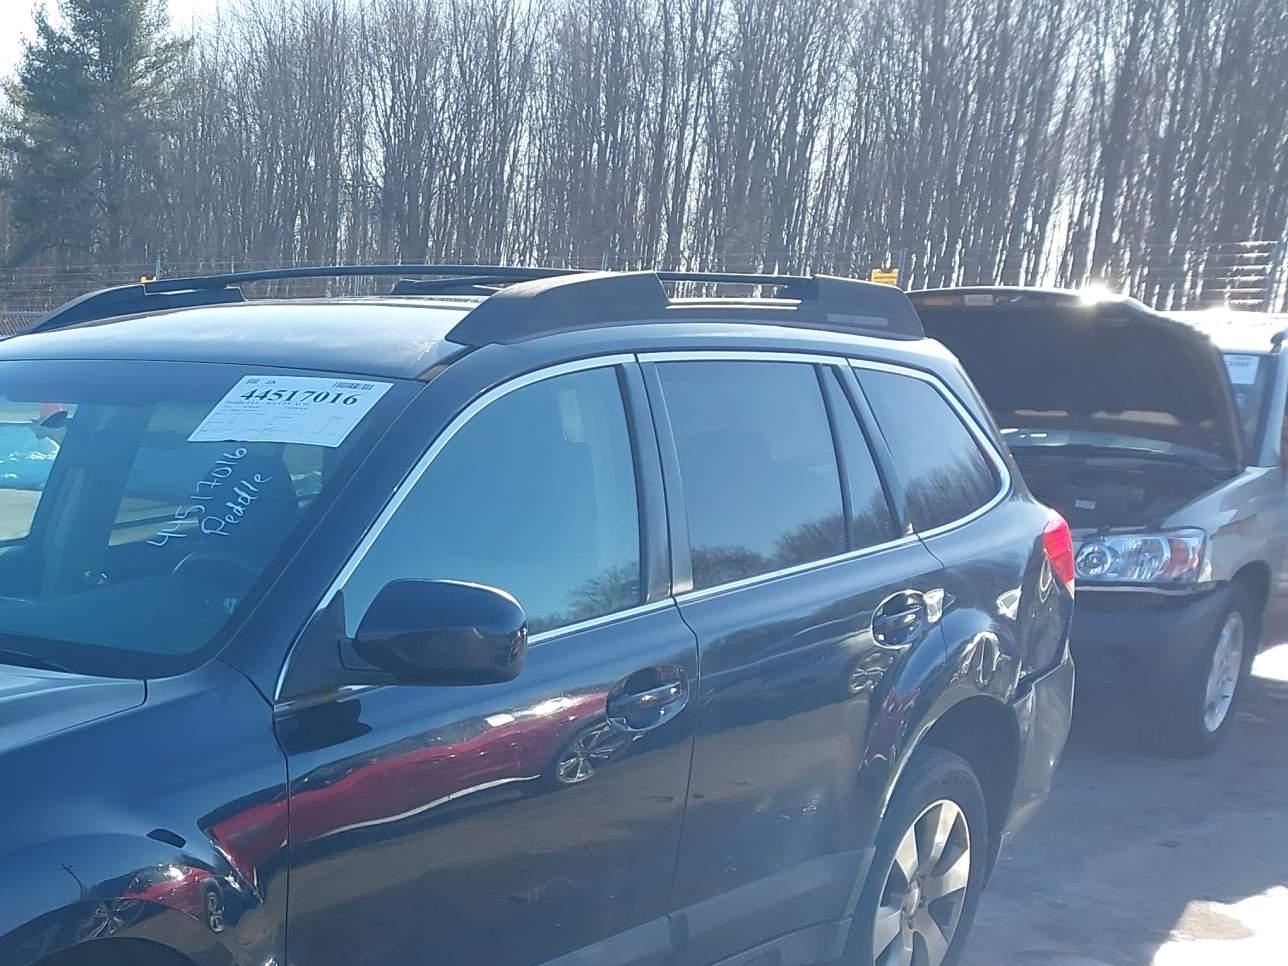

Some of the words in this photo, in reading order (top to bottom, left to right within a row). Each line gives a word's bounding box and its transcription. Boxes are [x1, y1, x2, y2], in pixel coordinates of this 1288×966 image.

[239, 388, 364, 406] 44517016
[144, 446, 248, 546] 44517016
[200, 473, 273, 536] Peddle
